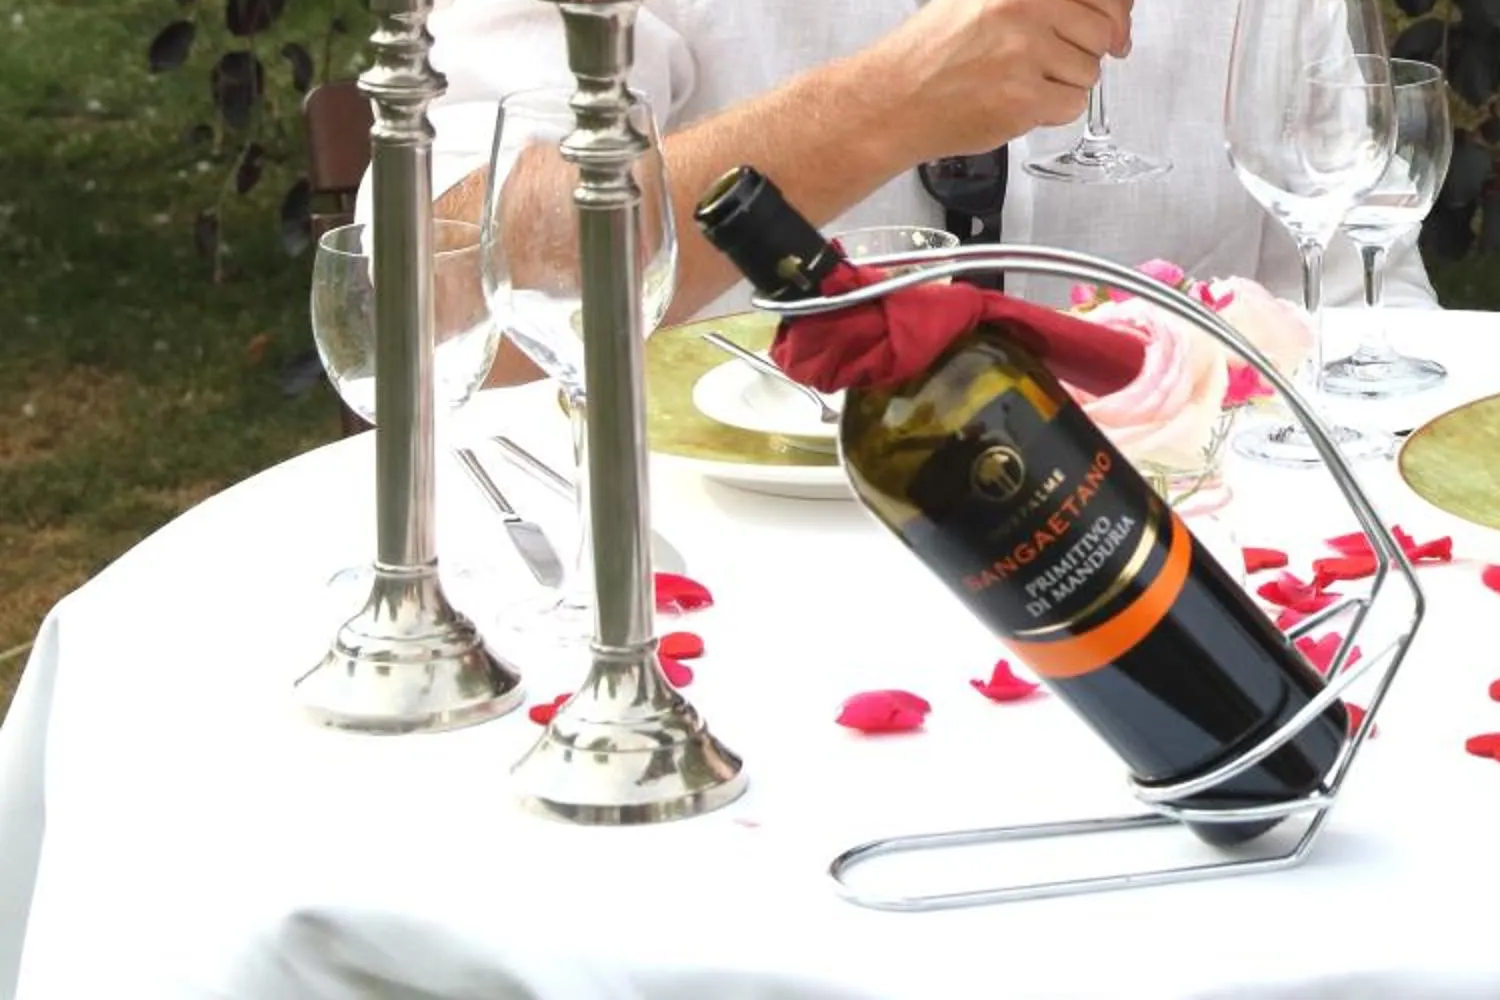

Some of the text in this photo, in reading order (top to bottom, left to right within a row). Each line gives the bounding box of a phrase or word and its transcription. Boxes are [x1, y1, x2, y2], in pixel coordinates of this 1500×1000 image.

[962, 452, 1111, 592] SANGAETANO
[1025, 515, 1111, 598] PRIMITIVO
[1025, 515, 1136, 618] DI MANDURIA
